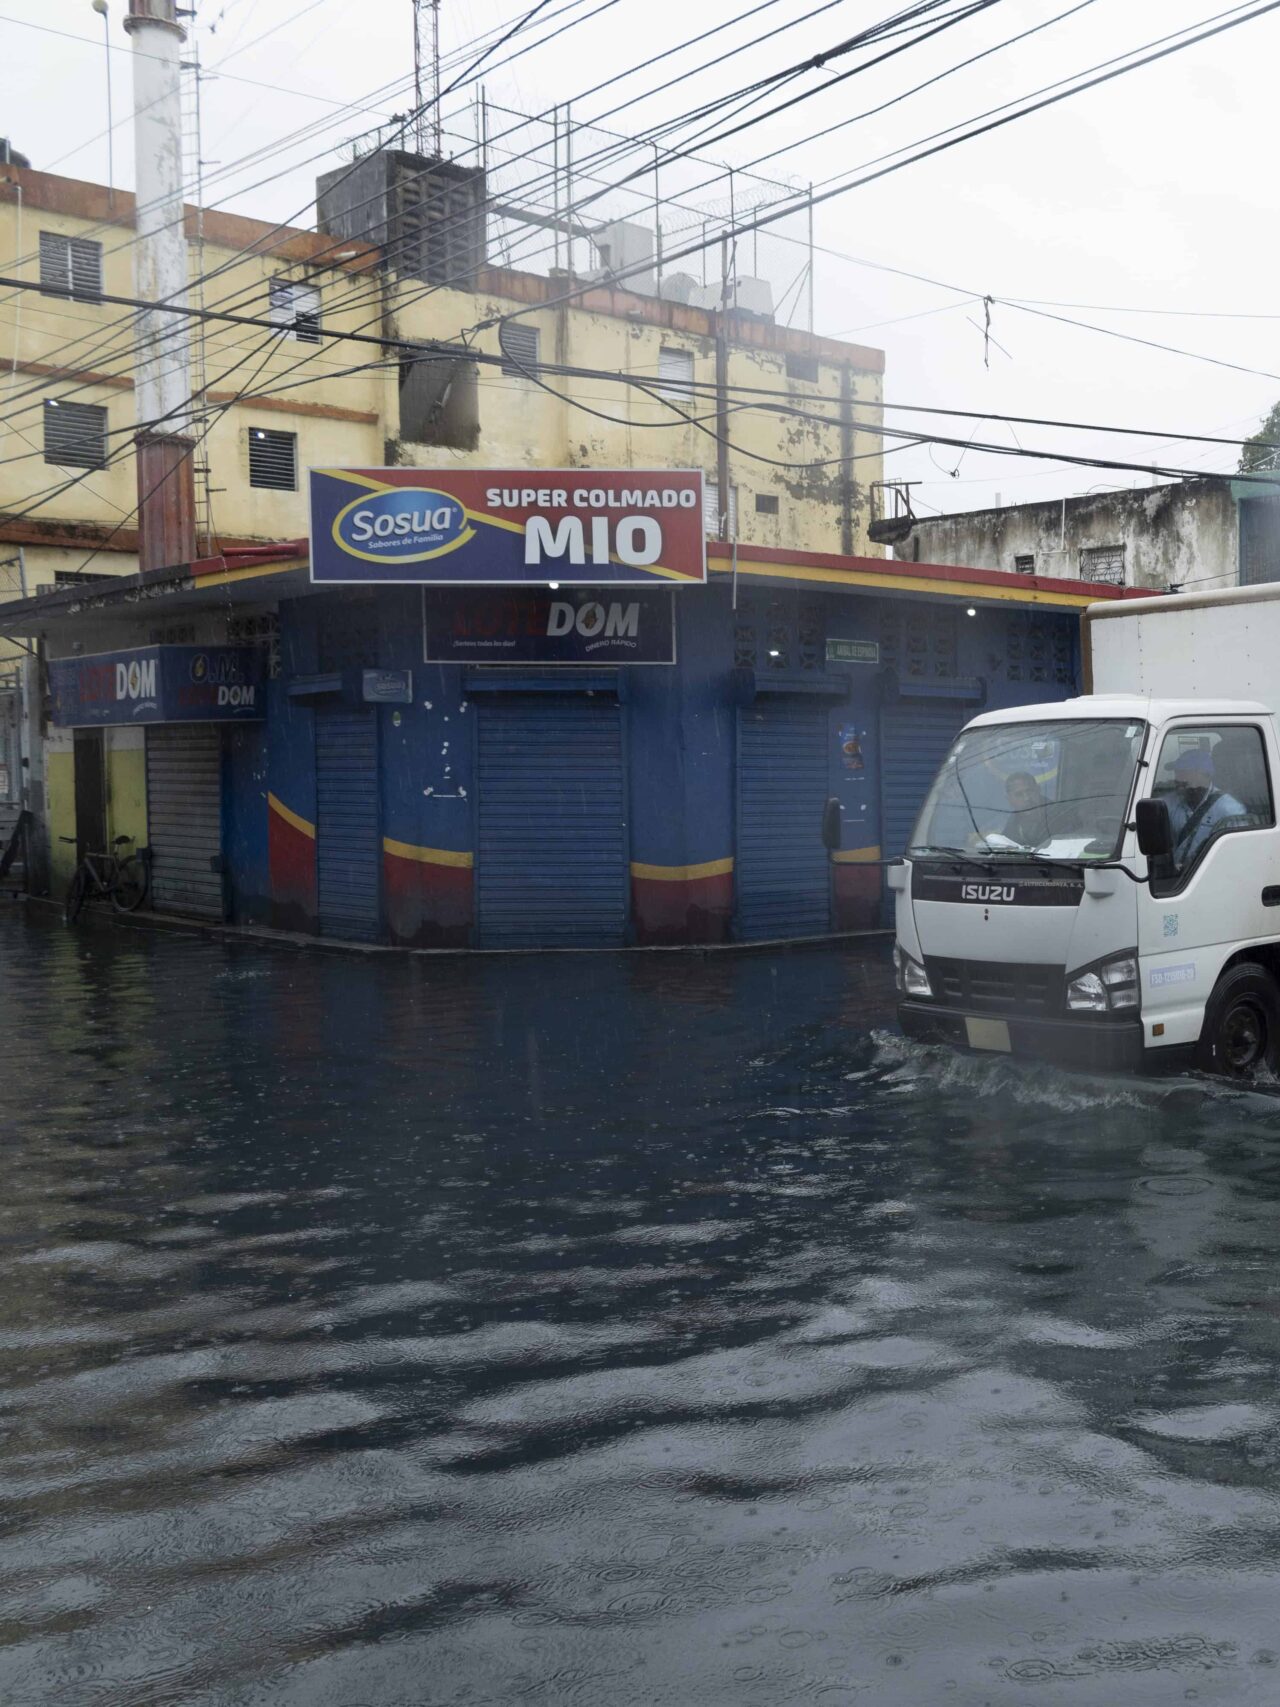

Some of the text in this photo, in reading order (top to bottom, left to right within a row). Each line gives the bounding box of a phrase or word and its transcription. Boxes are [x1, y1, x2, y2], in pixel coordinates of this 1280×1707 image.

[486, 488, 697, 509] SUPER COLMADO
[350, 505, 452, 542] Sosua
[367, 538, 401, 550] Sabores
[401, 537, 413, 545] de
[524, 515, 663, 566] MIO
[961, 884, 1015, 901] ISUZU
